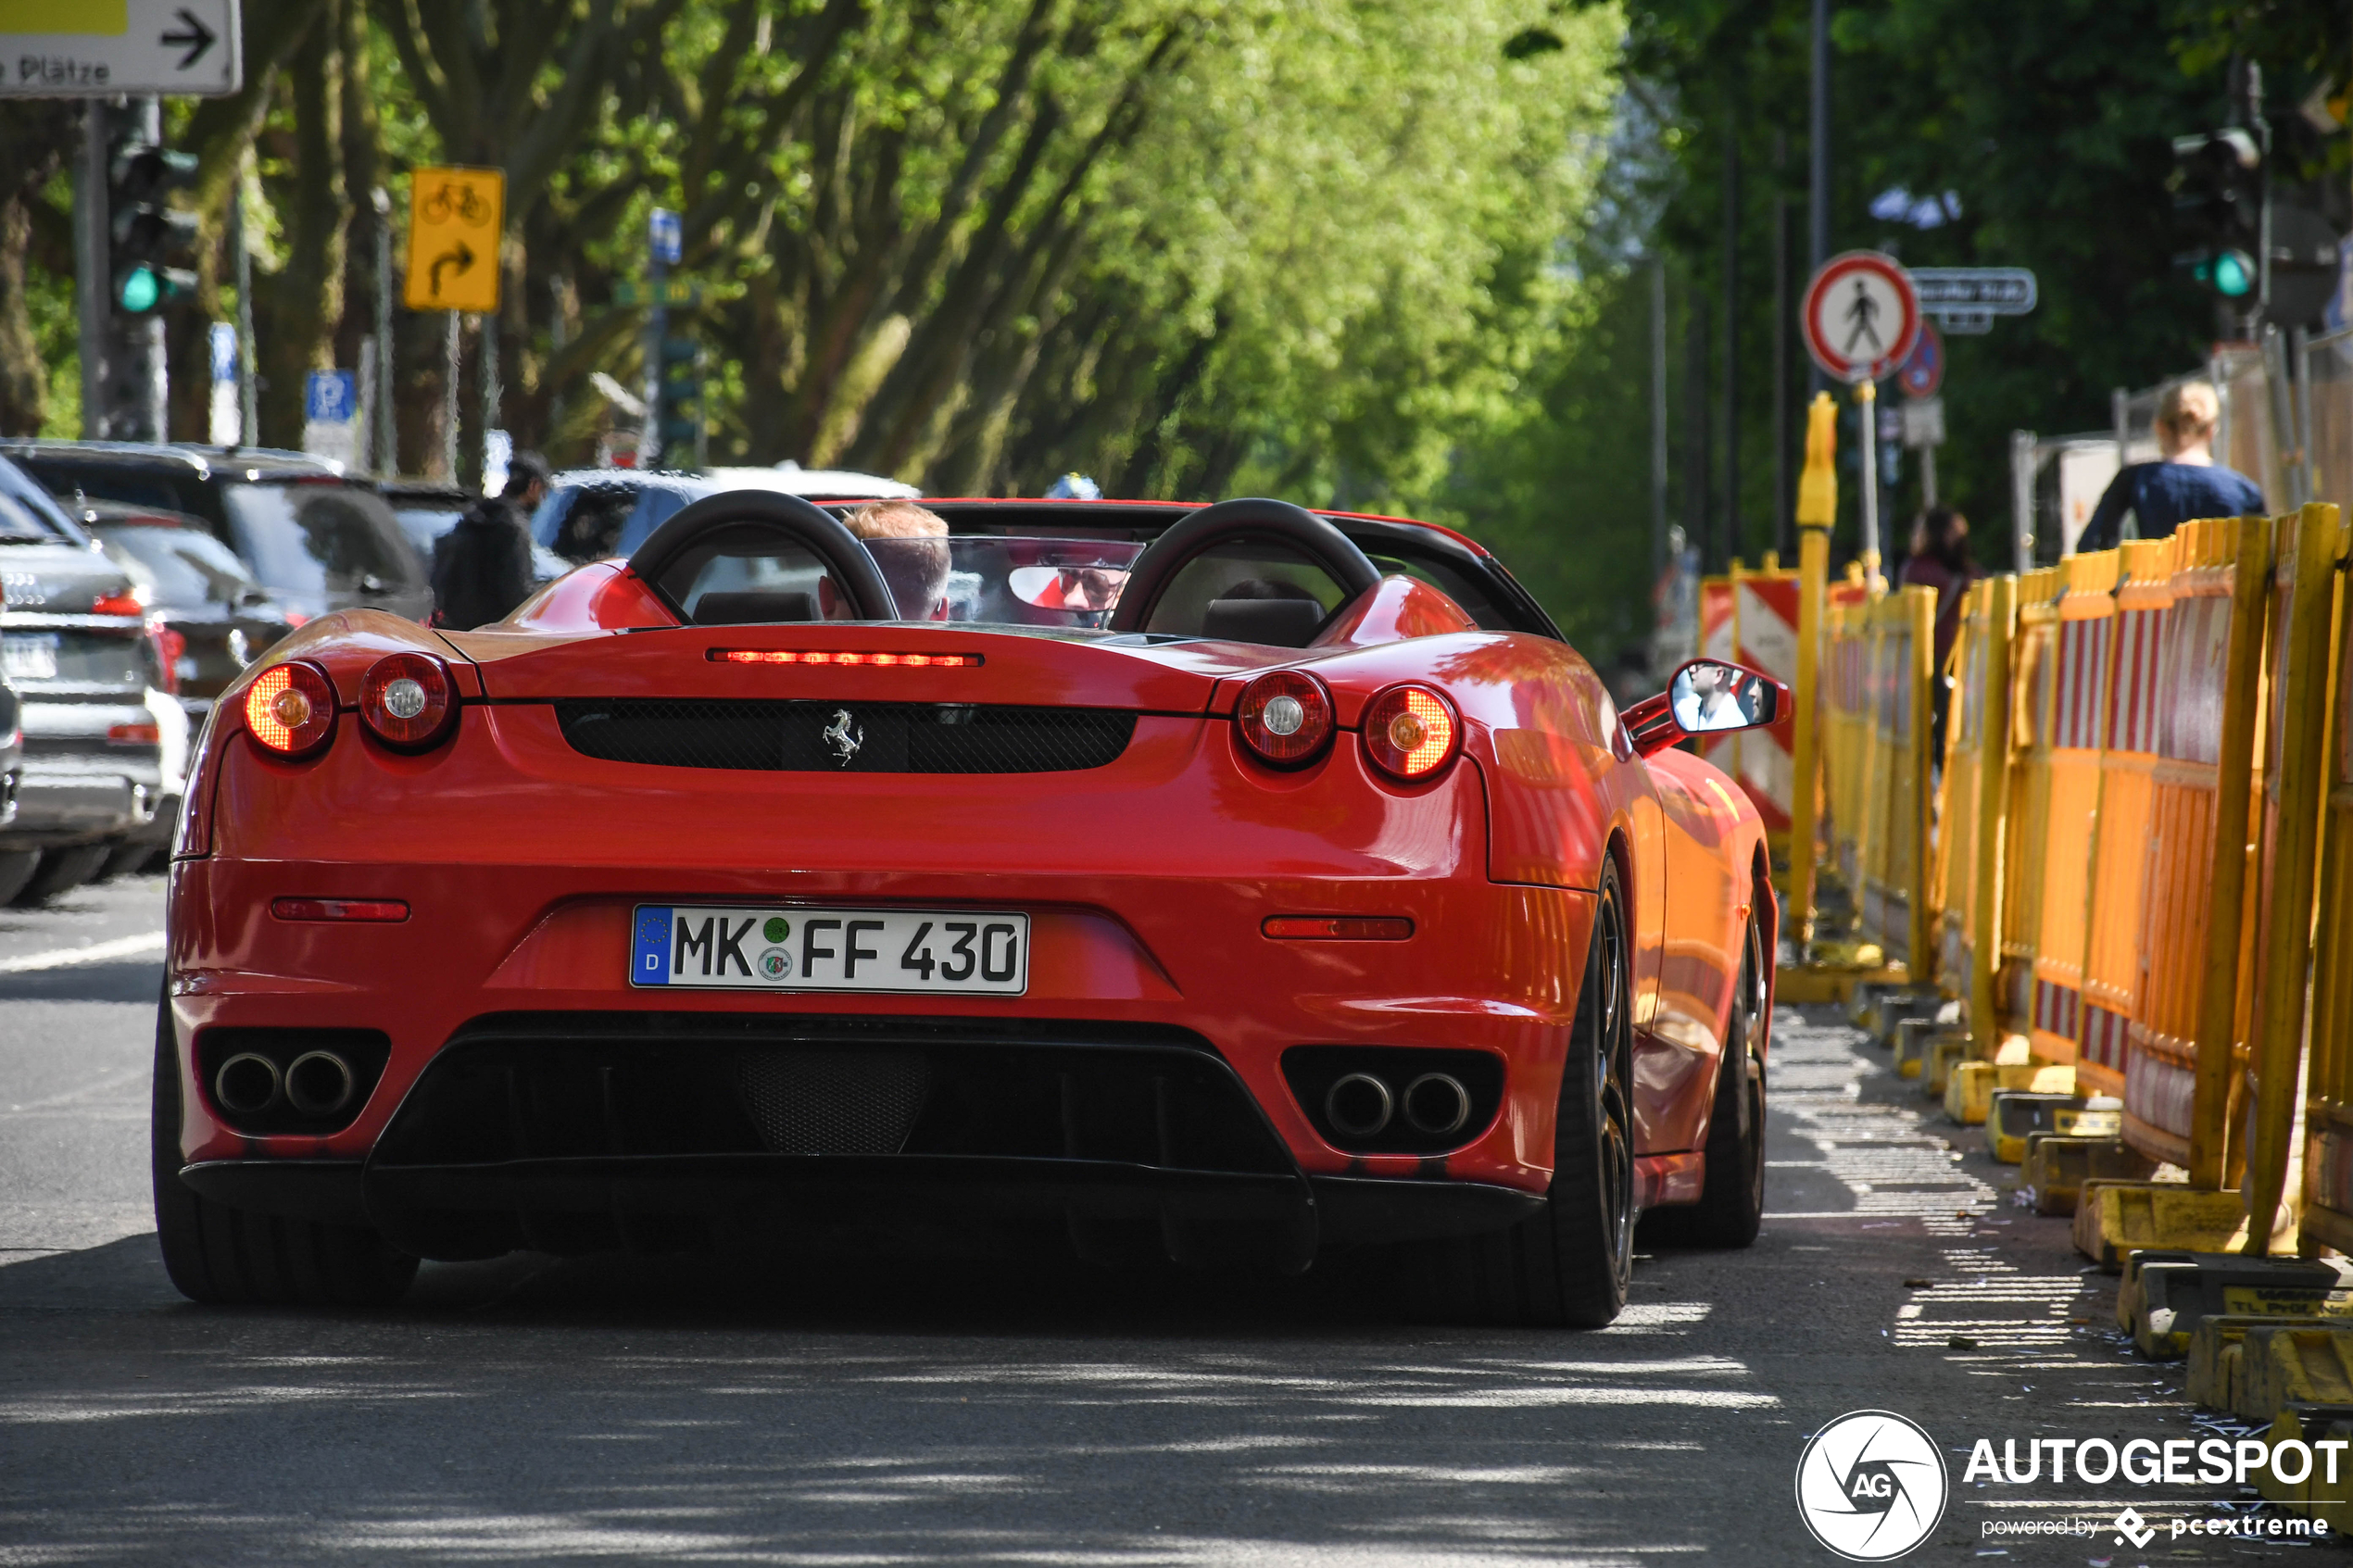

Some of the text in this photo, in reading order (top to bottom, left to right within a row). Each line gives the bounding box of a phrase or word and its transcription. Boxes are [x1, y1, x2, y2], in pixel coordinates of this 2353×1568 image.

[19, 55, 110, 84] Plätze
[646, 954, 659, 971] D
[674, 916, 1016, 981] MK FF 430
